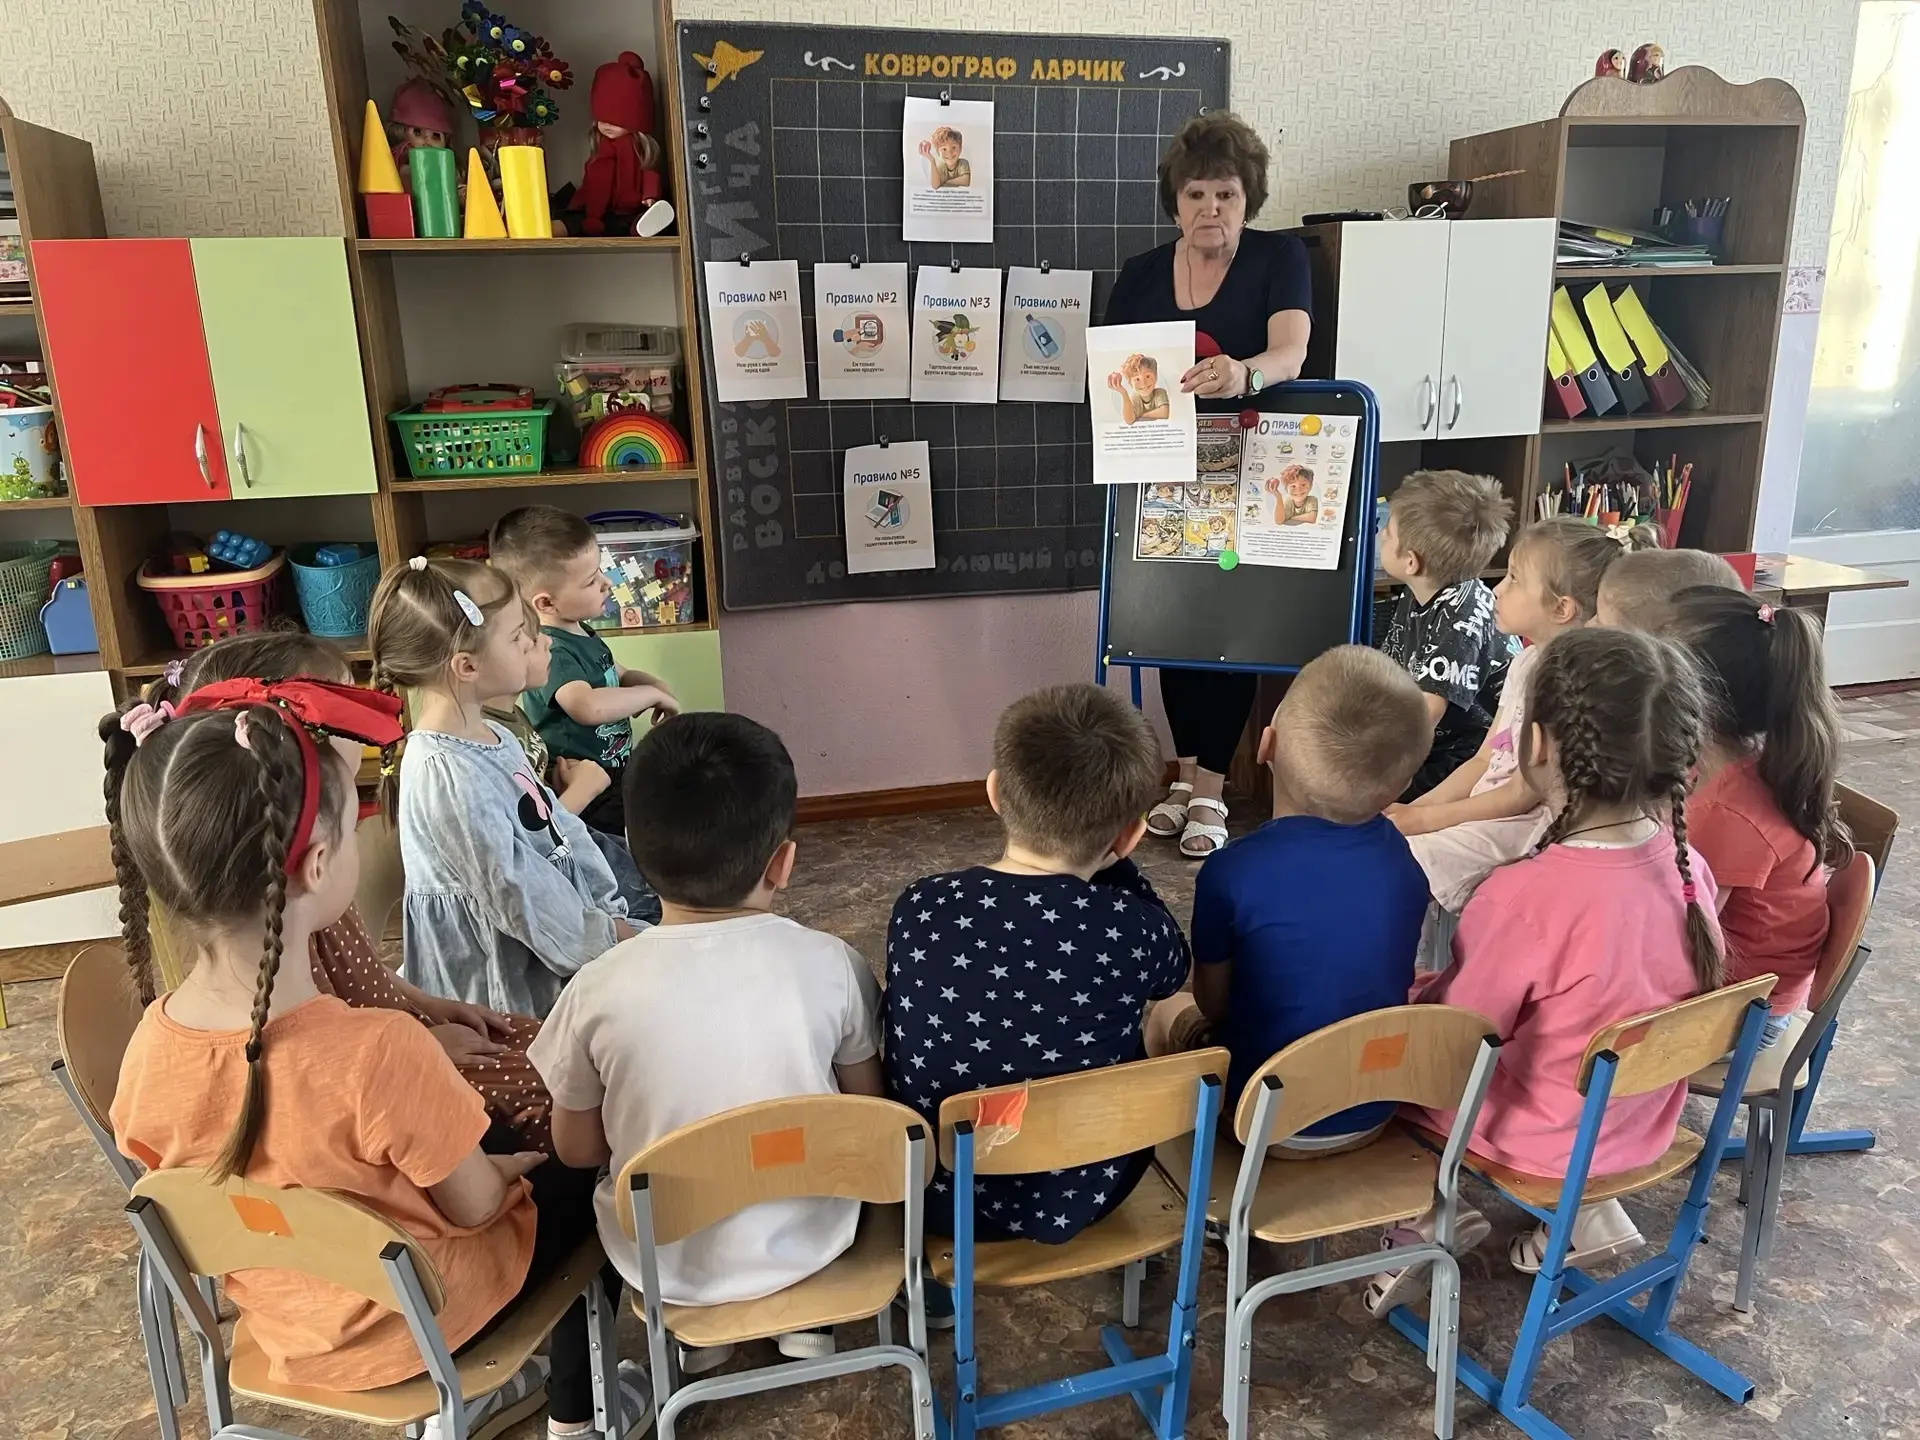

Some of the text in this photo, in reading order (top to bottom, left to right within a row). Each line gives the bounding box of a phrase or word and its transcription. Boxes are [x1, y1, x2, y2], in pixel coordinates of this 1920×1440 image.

[864, 53, 1126, 82] КОВРОГРАФ ЛАРЧИК
[719, 290, 788, 304] Правило №1
[826, 291, 897, 306] Правило №2
[923, 294, 991, 309] Правило №3
[1013, 295, 1081, 310] Правило №4
[853, 468, 921, 486] Правило №5
